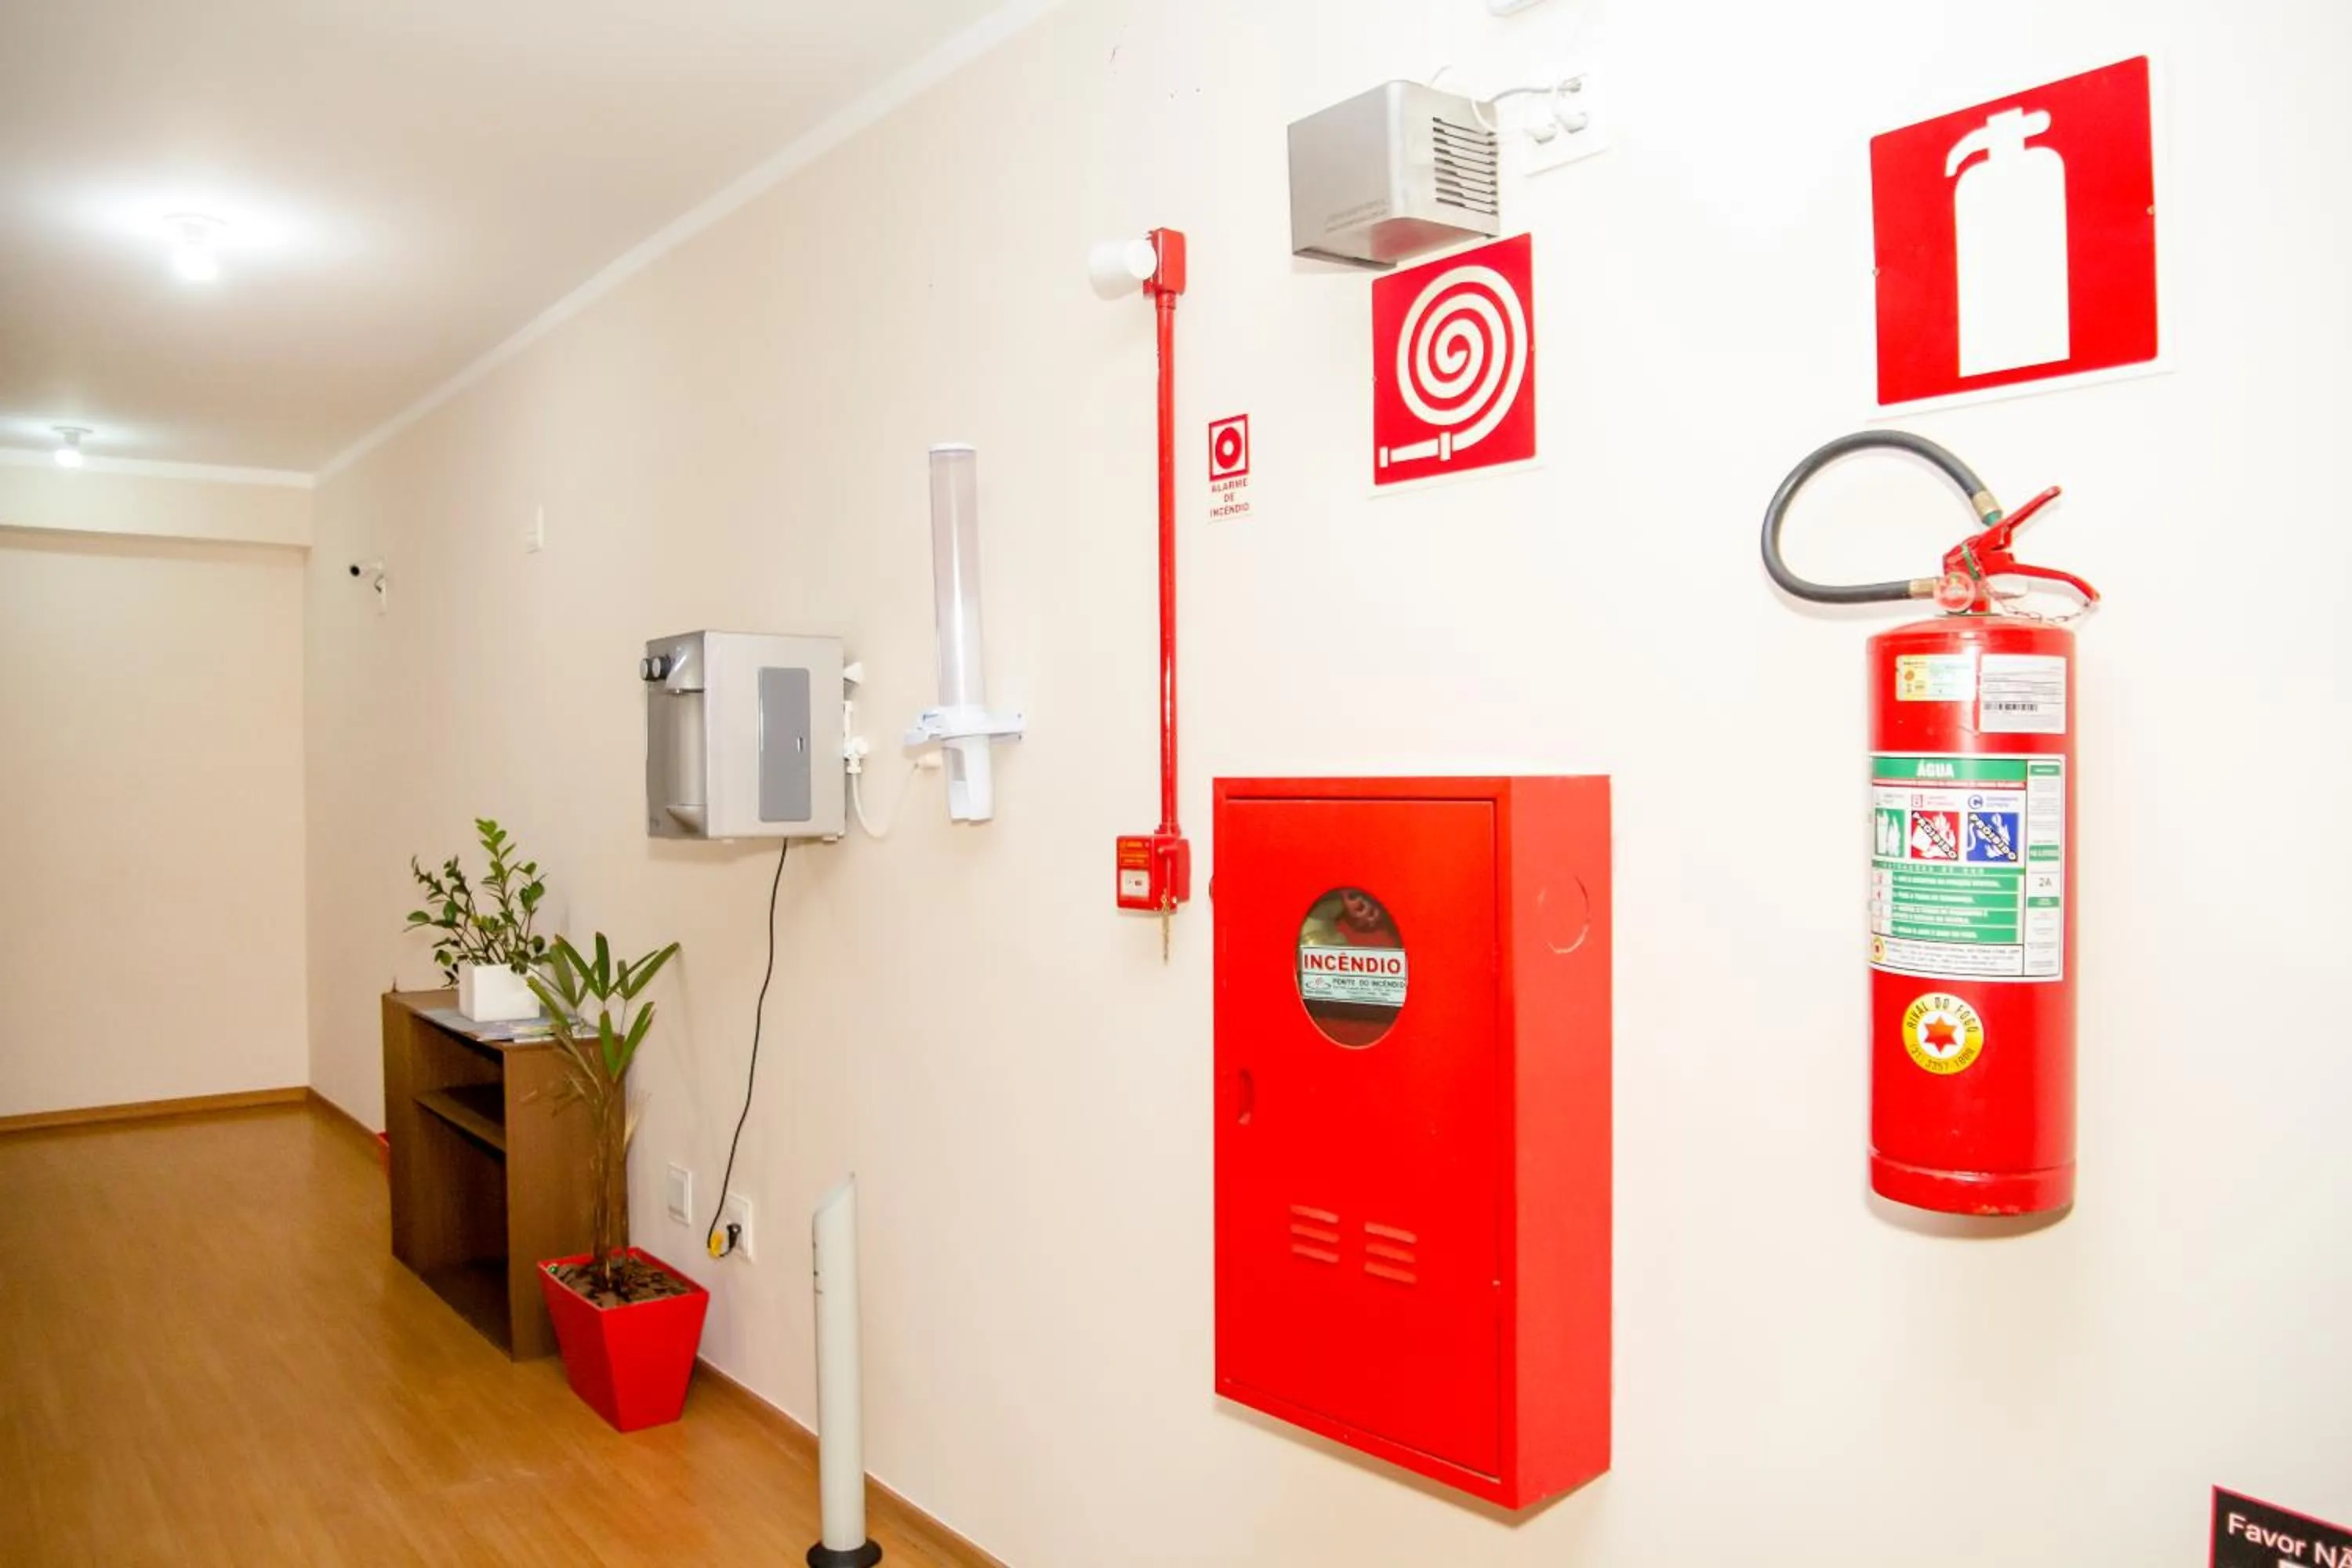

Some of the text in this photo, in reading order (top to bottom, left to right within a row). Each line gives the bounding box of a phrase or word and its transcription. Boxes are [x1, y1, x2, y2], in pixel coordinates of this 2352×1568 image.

[1211, 477, 1248, 493] ALARME
[1224, 492, 1235, 503] DE
[1916, 758, 1955, 778] ÁGUA
[1912, 811, 1958, 859] PROIBIDO
[1969, 814, 2016, 860] PROIBIDO
[1304, 952, 1402, 975] INCÊNDIO
[1907, 996, 1980, 1033] RIVAL DO FOGO
[2227, 1512, 2307, 1558] Favor
